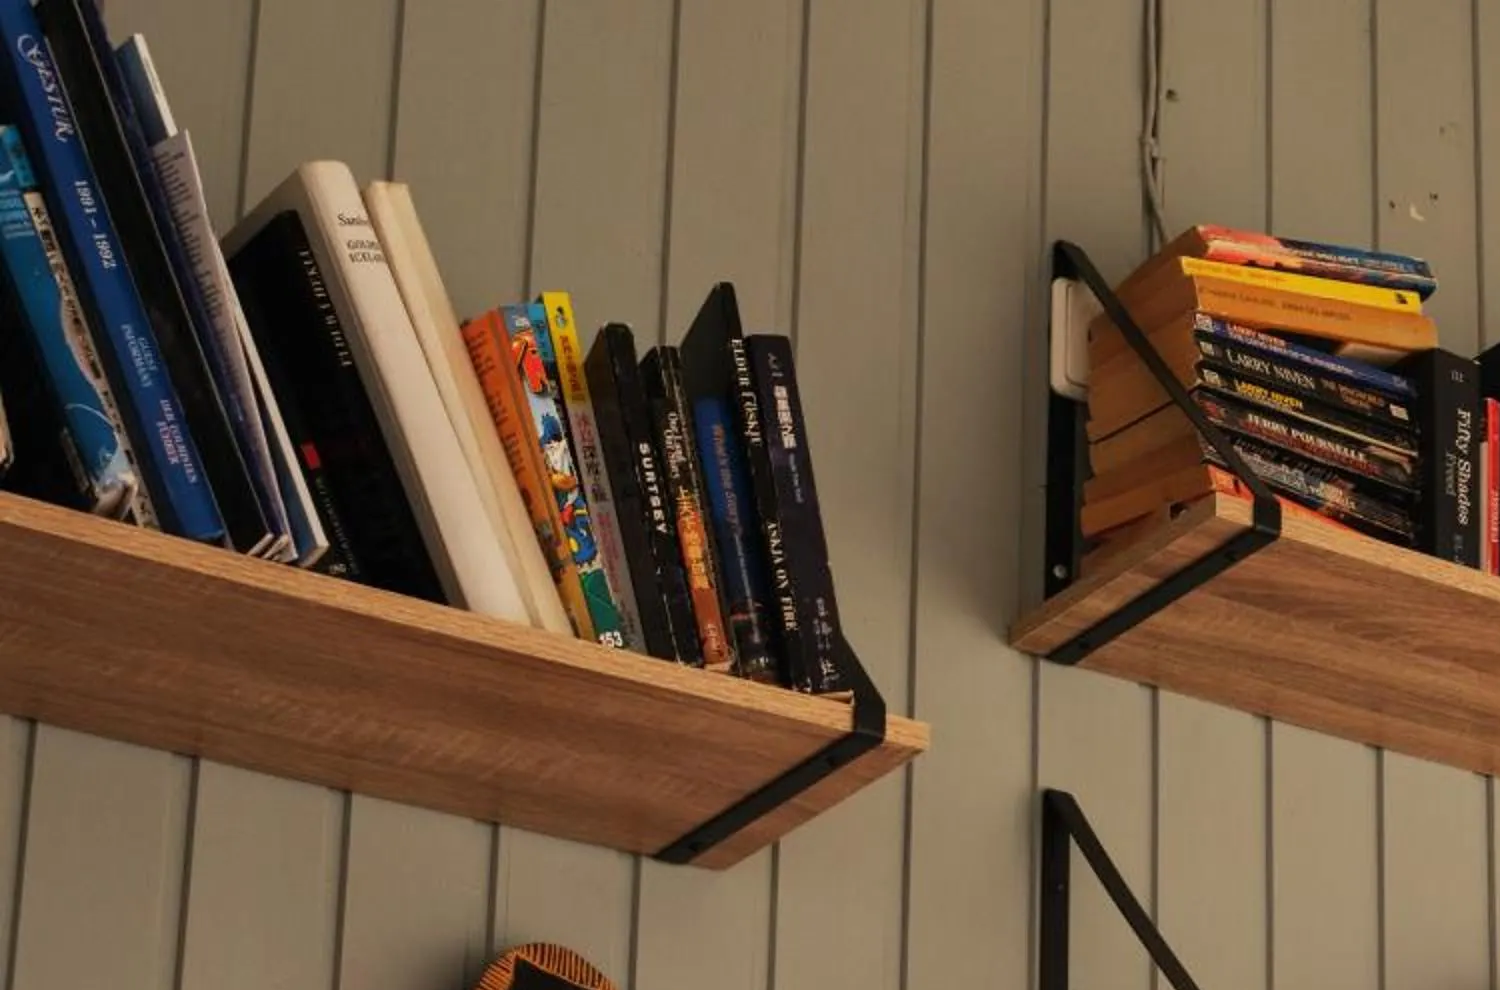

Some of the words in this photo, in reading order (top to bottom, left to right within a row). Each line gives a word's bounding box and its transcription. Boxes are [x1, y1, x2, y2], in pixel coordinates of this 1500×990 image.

[1226, 348, 1271, 376] LARRY
[1272, 365, 1315, 390] NIVEN
[638, 442, 668, 533] SURTSEY
[1457, 458, 1472, 526] Shades
[765, 522, 785, 565] ASKJA
[774, 568, 789, 589] ON
[779, 596, 798, 630] FIRE
